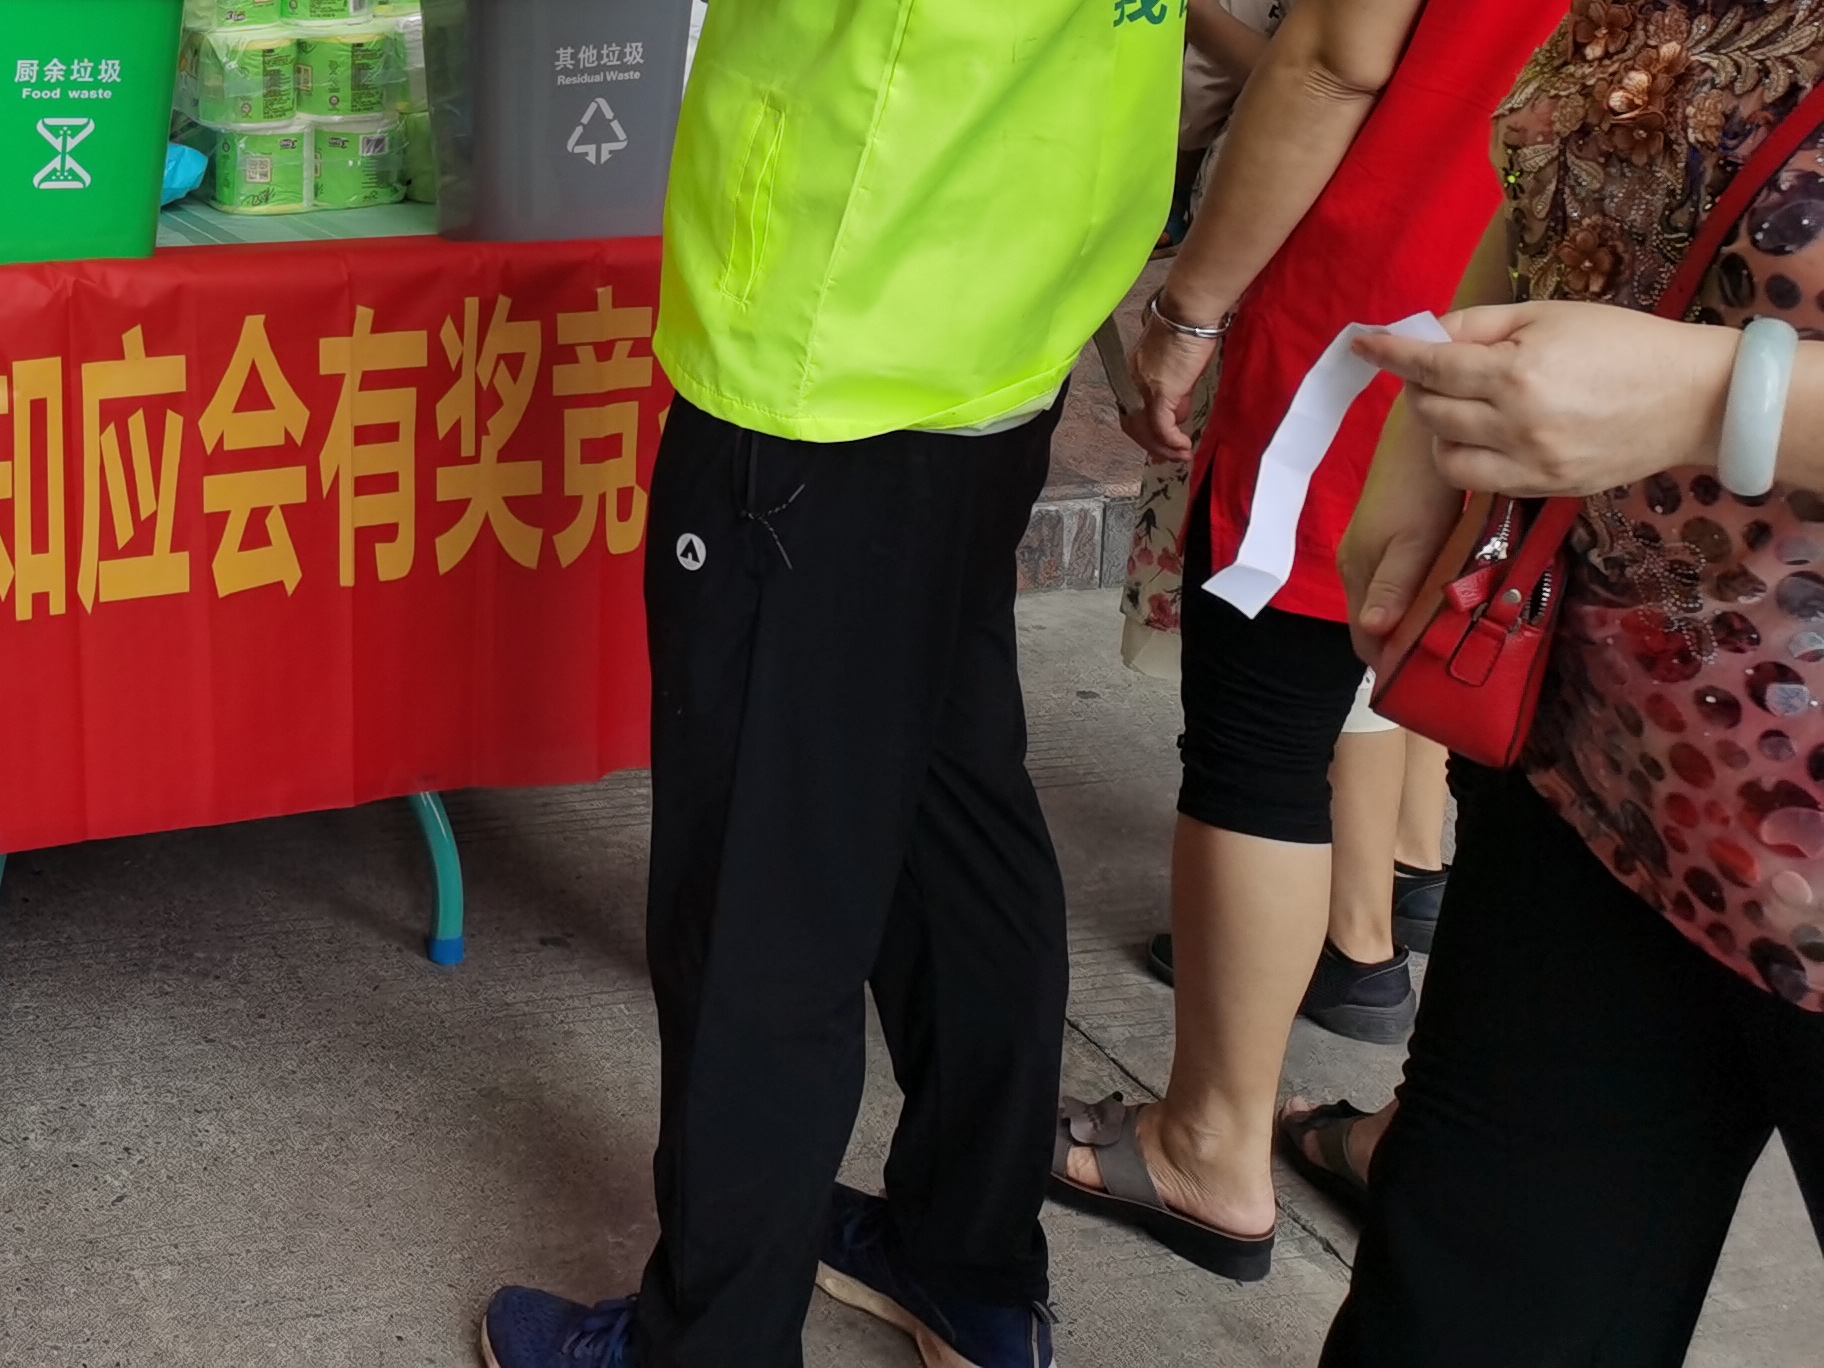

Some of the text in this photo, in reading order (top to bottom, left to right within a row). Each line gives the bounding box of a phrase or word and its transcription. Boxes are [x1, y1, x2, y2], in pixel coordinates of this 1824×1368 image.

[554, 42, 645, 71] 其他垃圾
[14, 58, 122, 84] 厨余垃圾
[557, 70, 641, 86] Residual Waste
[21, 87, 113, 100] Food waste
